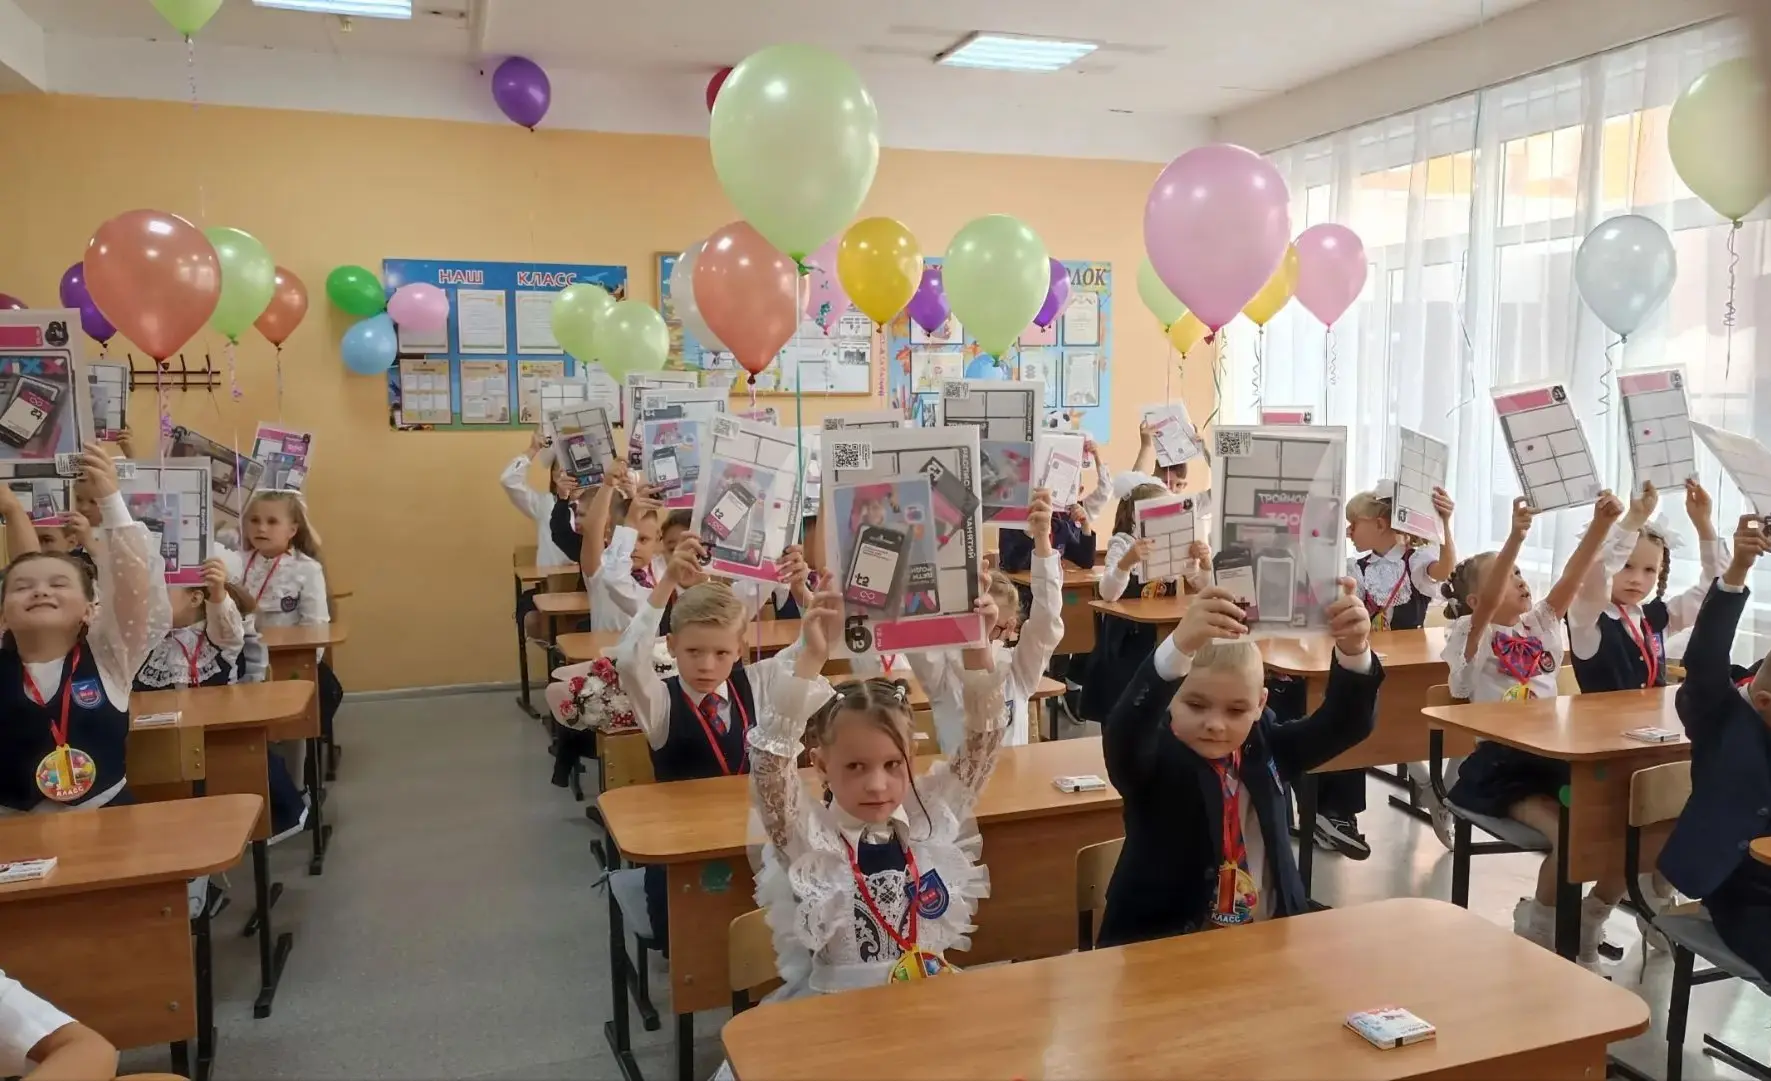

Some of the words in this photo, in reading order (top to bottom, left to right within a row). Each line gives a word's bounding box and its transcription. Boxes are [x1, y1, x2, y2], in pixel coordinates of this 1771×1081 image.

[438, 268, 485, 285] НАШ
[517, 271, 577, 287] КЛАСС
[1066, 267, 1107, 286] ЛОК
[855, 572, 870, 588] t2
[1211, 911, 1241, 923] КЛАСС
